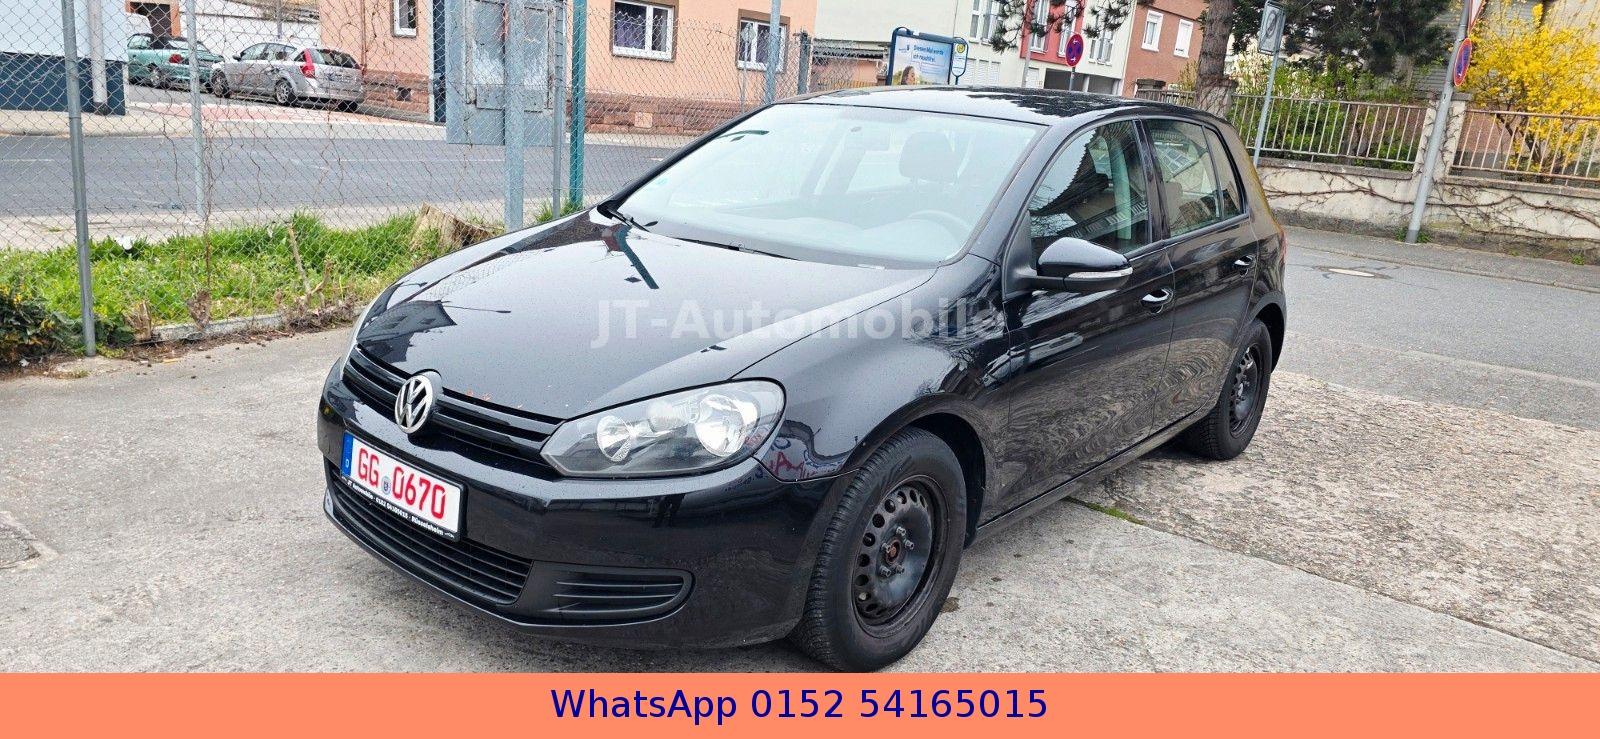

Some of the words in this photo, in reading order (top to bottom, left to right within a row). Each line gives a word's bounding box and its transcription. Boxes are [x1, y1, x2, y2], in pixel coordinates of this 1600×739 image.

[395, 375, 433, 434] VW
[358, 447, 380, 488] GG
[392, 466, 446, 520] 0670
